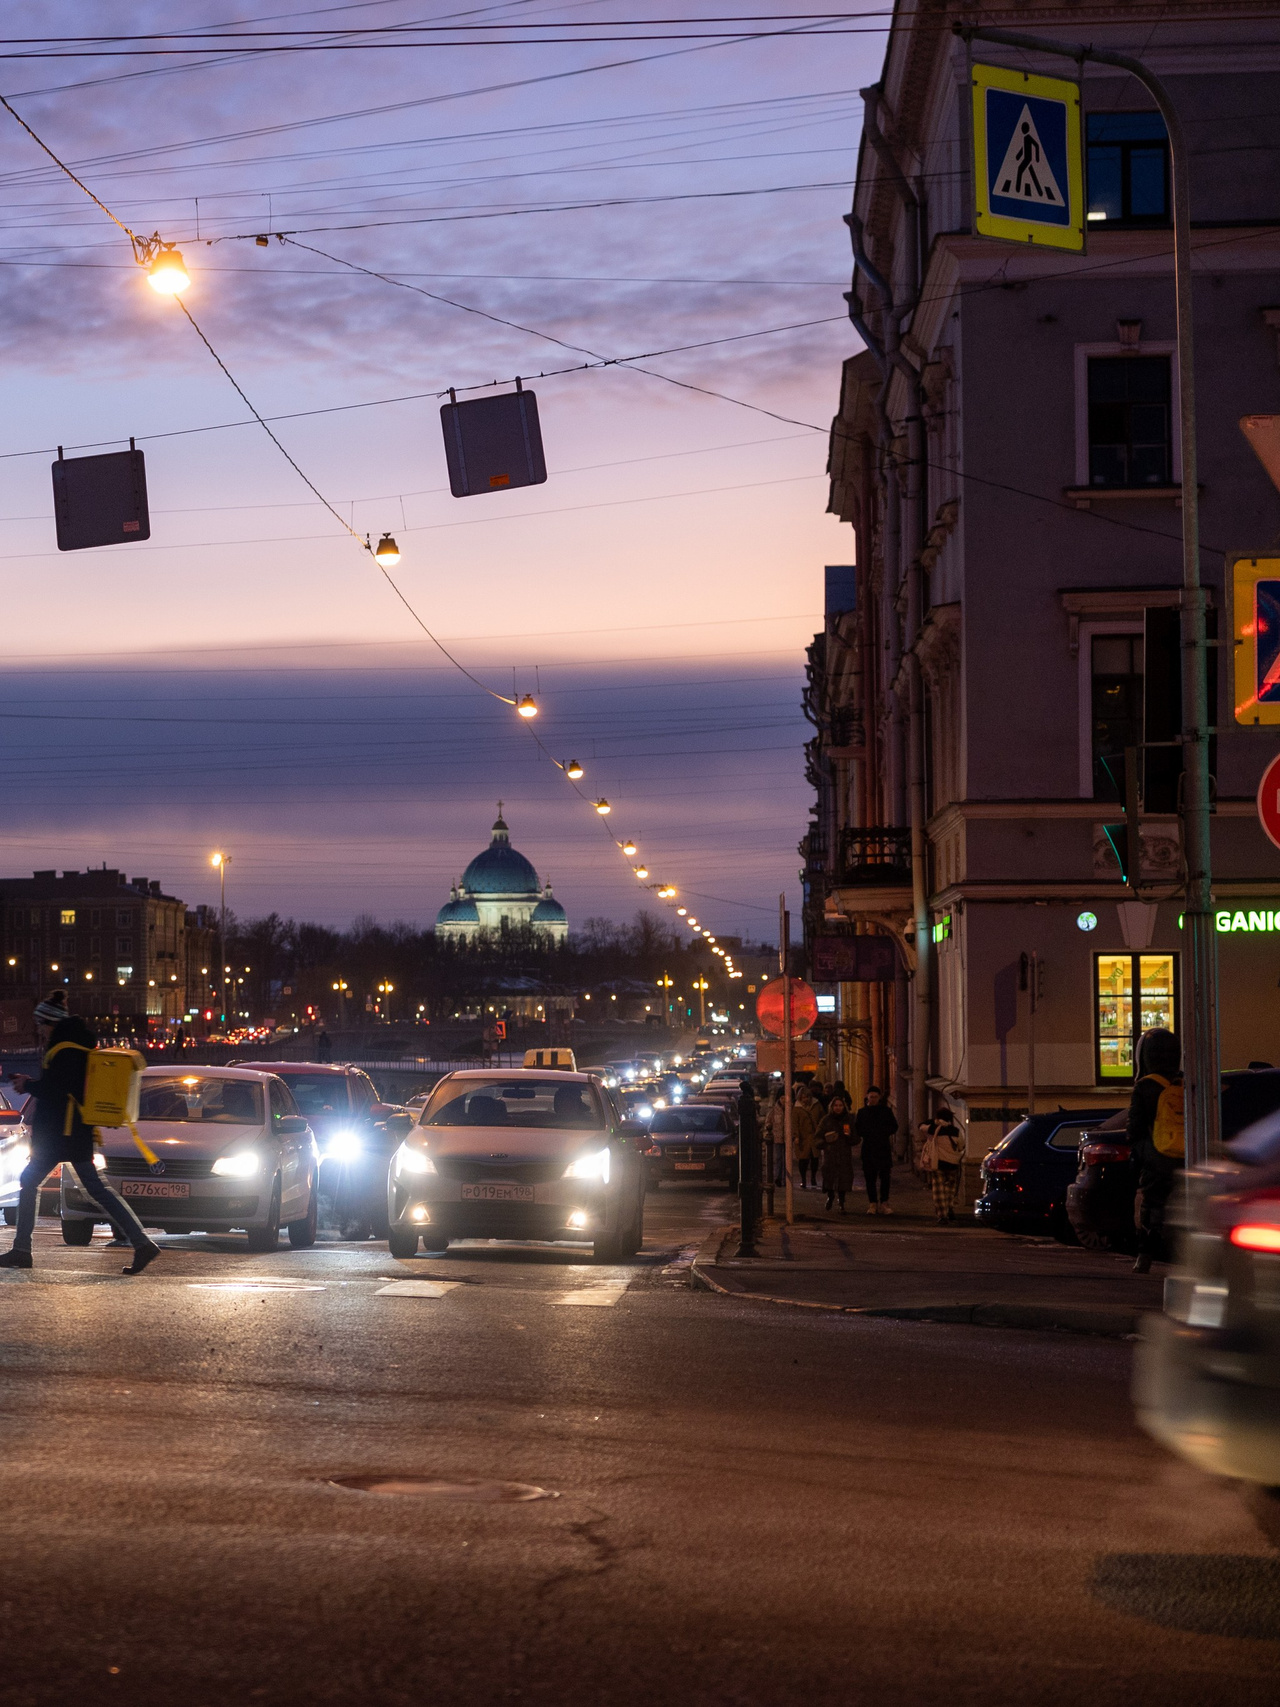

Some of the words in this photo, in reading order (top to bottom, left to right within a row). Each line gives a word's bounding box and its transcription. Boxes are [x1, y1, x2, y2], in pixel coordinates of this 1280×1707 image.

[1178, 911, 1280, 932] GANI
[125, 1183, 168, 1196] О276ХС
[170, 1184, 186, 1194] 198
